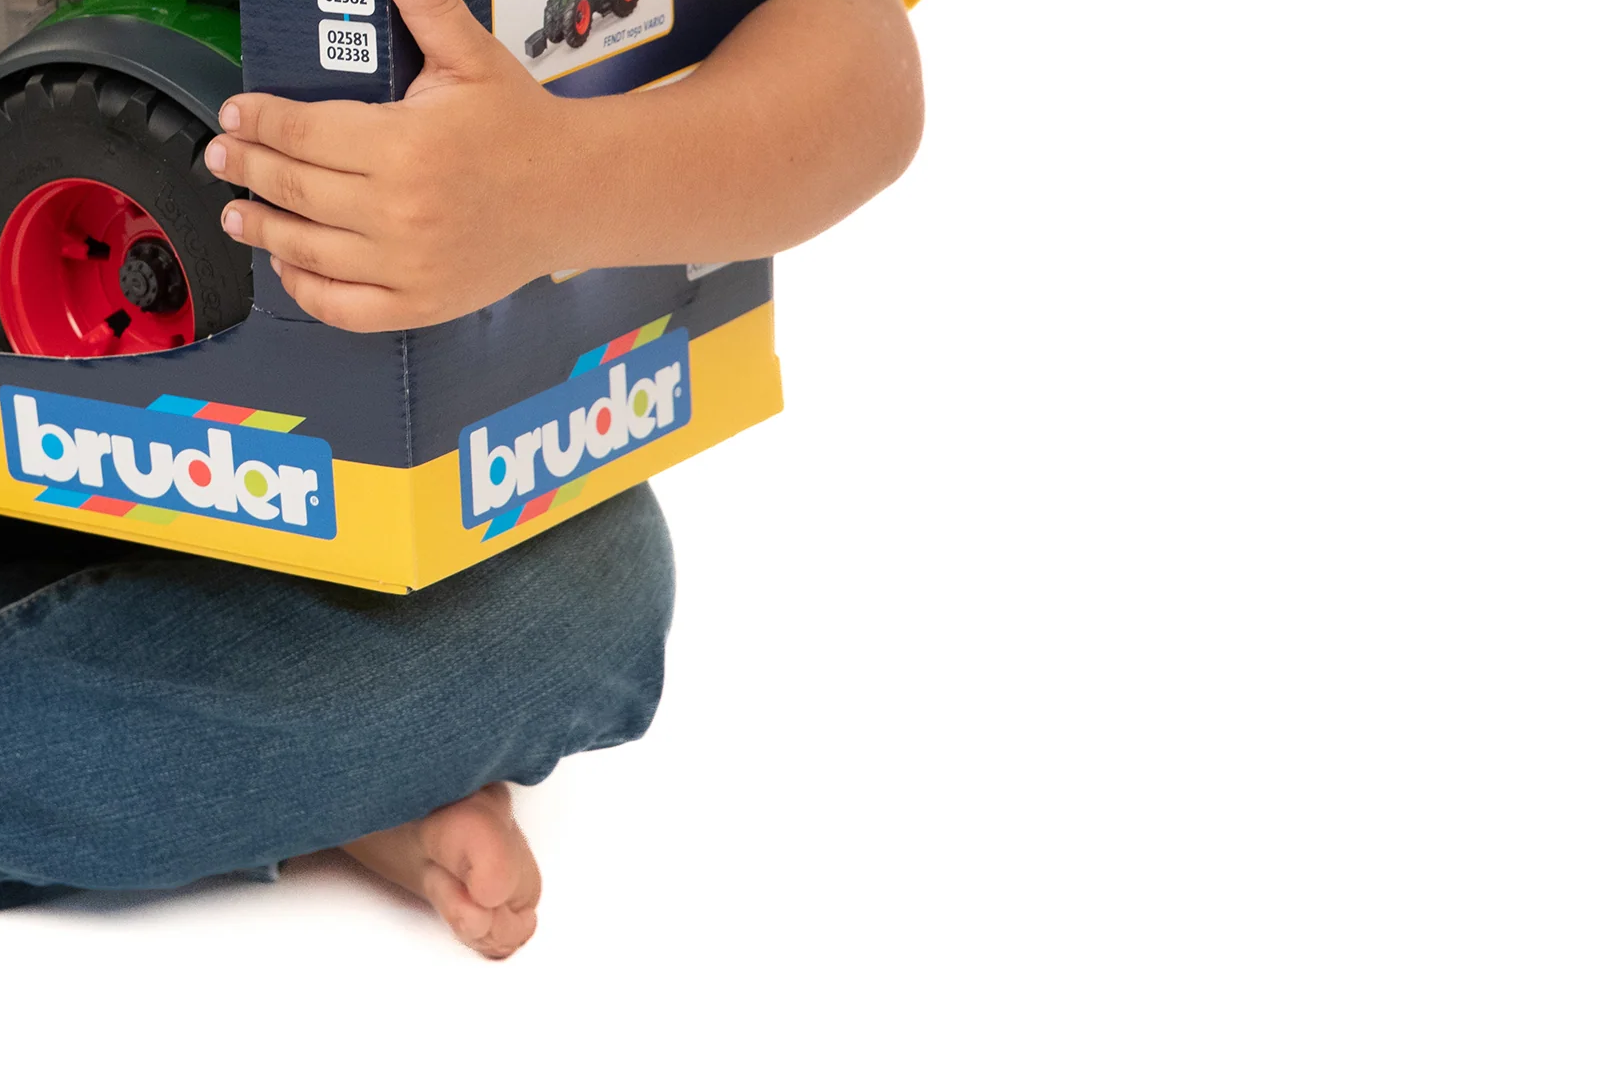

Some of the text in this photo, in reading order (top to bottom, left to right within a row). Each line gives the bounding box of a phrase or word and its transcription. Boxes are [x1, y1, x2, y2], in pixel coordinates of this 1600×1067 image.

[326, 46, 370, 63] 02338
[327, 30, 369, 46] 02581
[13, 394, 318, 526] bruder
[470, 361, 681, 517] bruder
